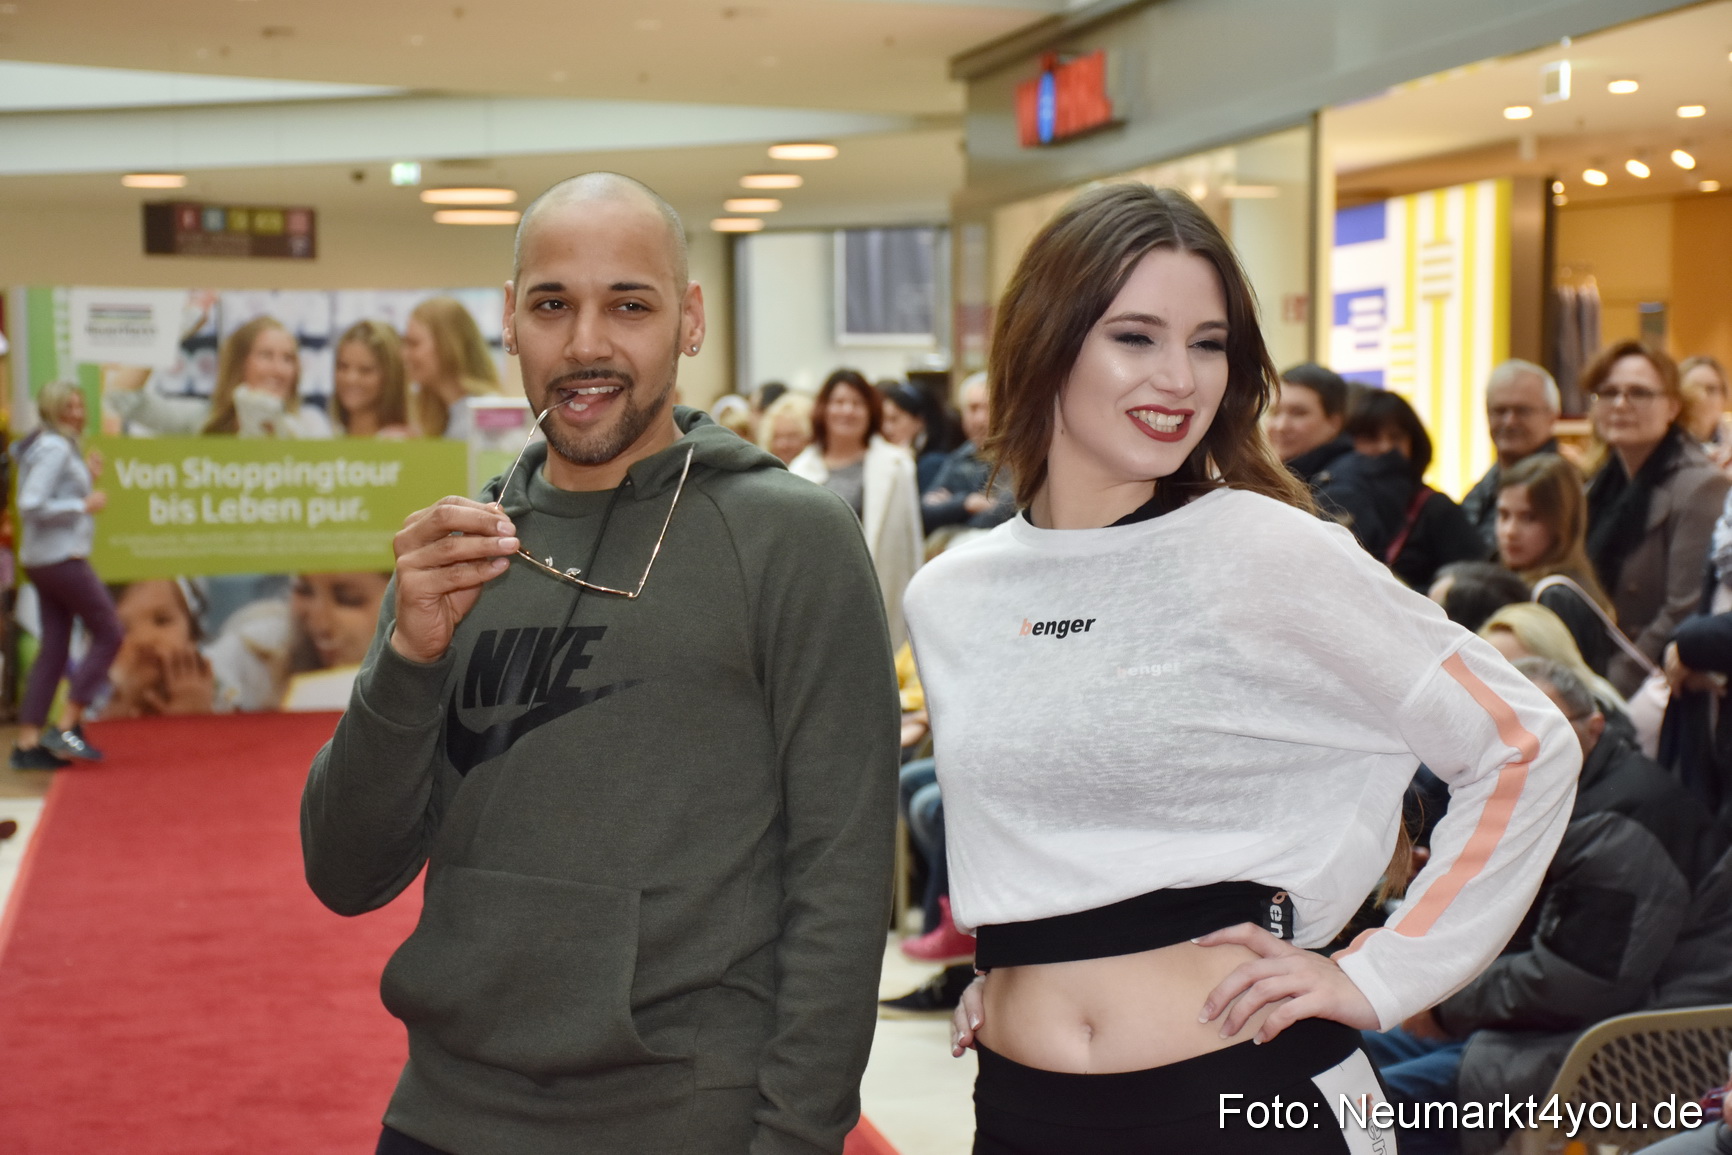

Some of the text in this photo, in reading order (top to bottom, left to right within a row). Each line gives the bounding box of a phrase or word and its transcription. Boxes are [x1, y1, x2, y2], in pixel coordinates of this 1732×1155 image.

[115, 456, 402, 493] Von Shoppingtour
[150, 494, 370, 528] bis Leben pur.
[1019, 617, 1096, 640] benger
[463, 626, 608, 709] NIKE
[1117, 661, 1182, 679] benger
[1269, 891, 1284, 939] ben
